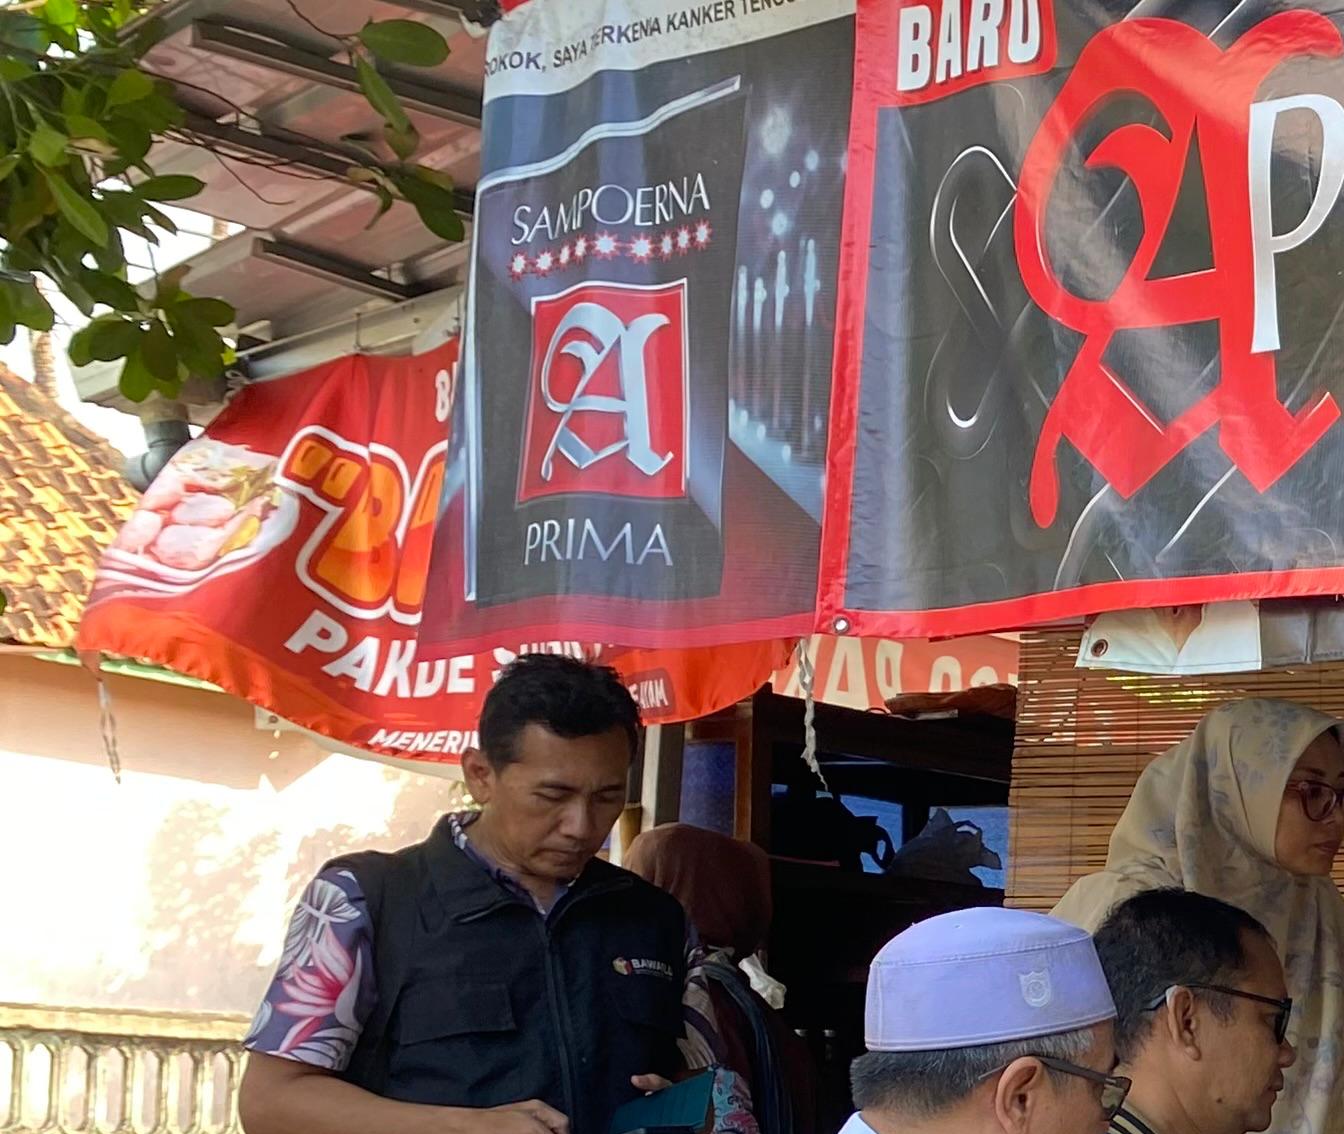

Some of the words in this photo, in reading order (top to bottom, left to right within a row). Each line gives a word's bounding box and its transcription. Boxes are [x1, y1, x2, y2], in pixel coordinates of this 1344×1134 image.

[553, 40, 588, 68] SAYA
[666, 2, 735, 33] KANKER
[896, 0, 1041, 91] BARU
[511, 172, 711, 245] SAMPOERNA
[523, 517, 674, 567] PRIMA
